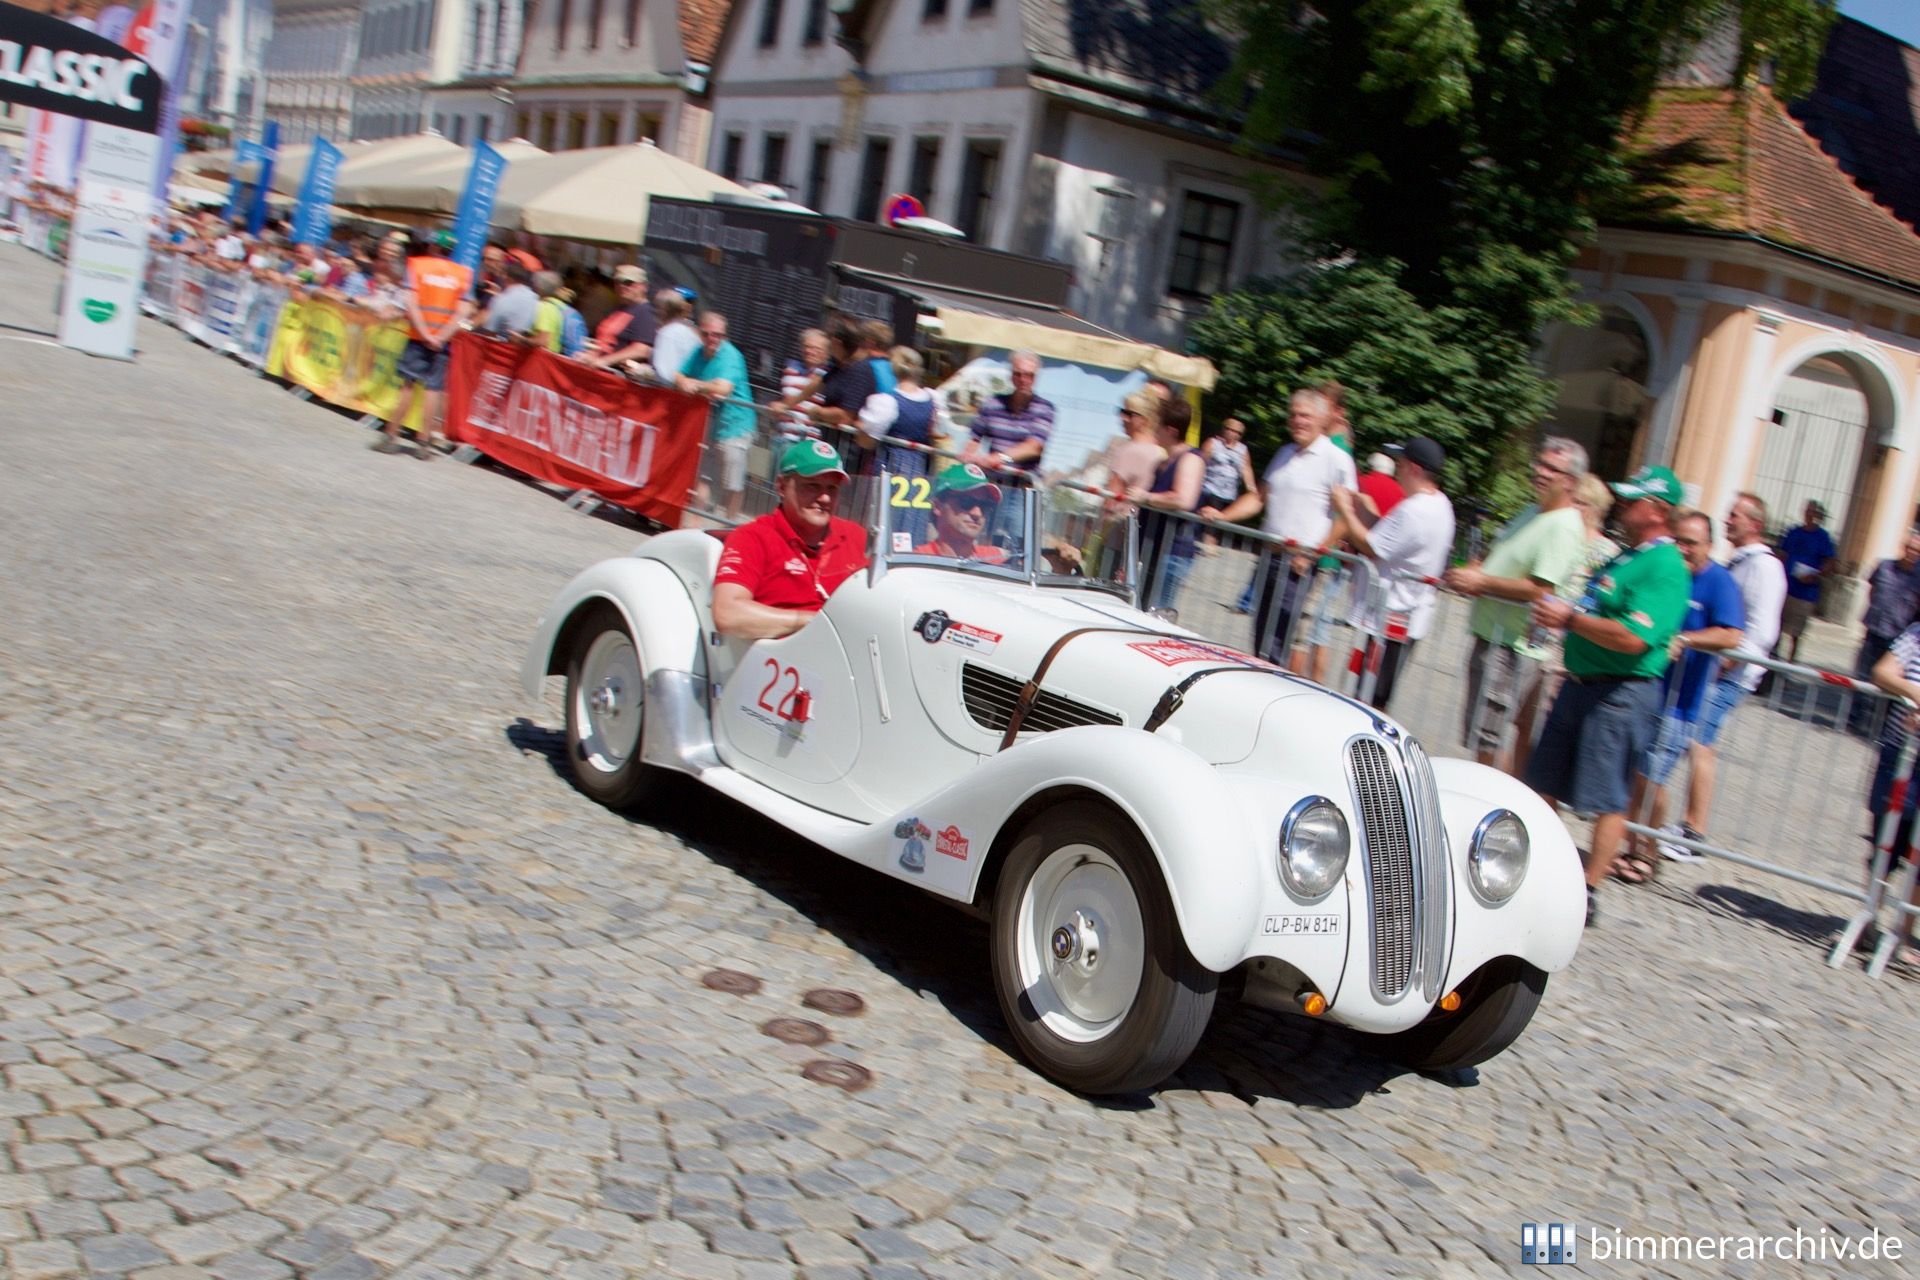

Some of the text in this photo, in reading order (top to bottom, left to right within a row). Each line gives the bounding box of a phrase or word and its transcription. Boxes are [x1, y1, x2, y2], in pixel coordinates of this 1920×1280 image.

[0, 39, 148, 112] LASSIC
[890, 475, 933, 509] 22
[758, 658, 800, 722] 22
[1265, 917, 1338, 933] CLP-BW 81H
